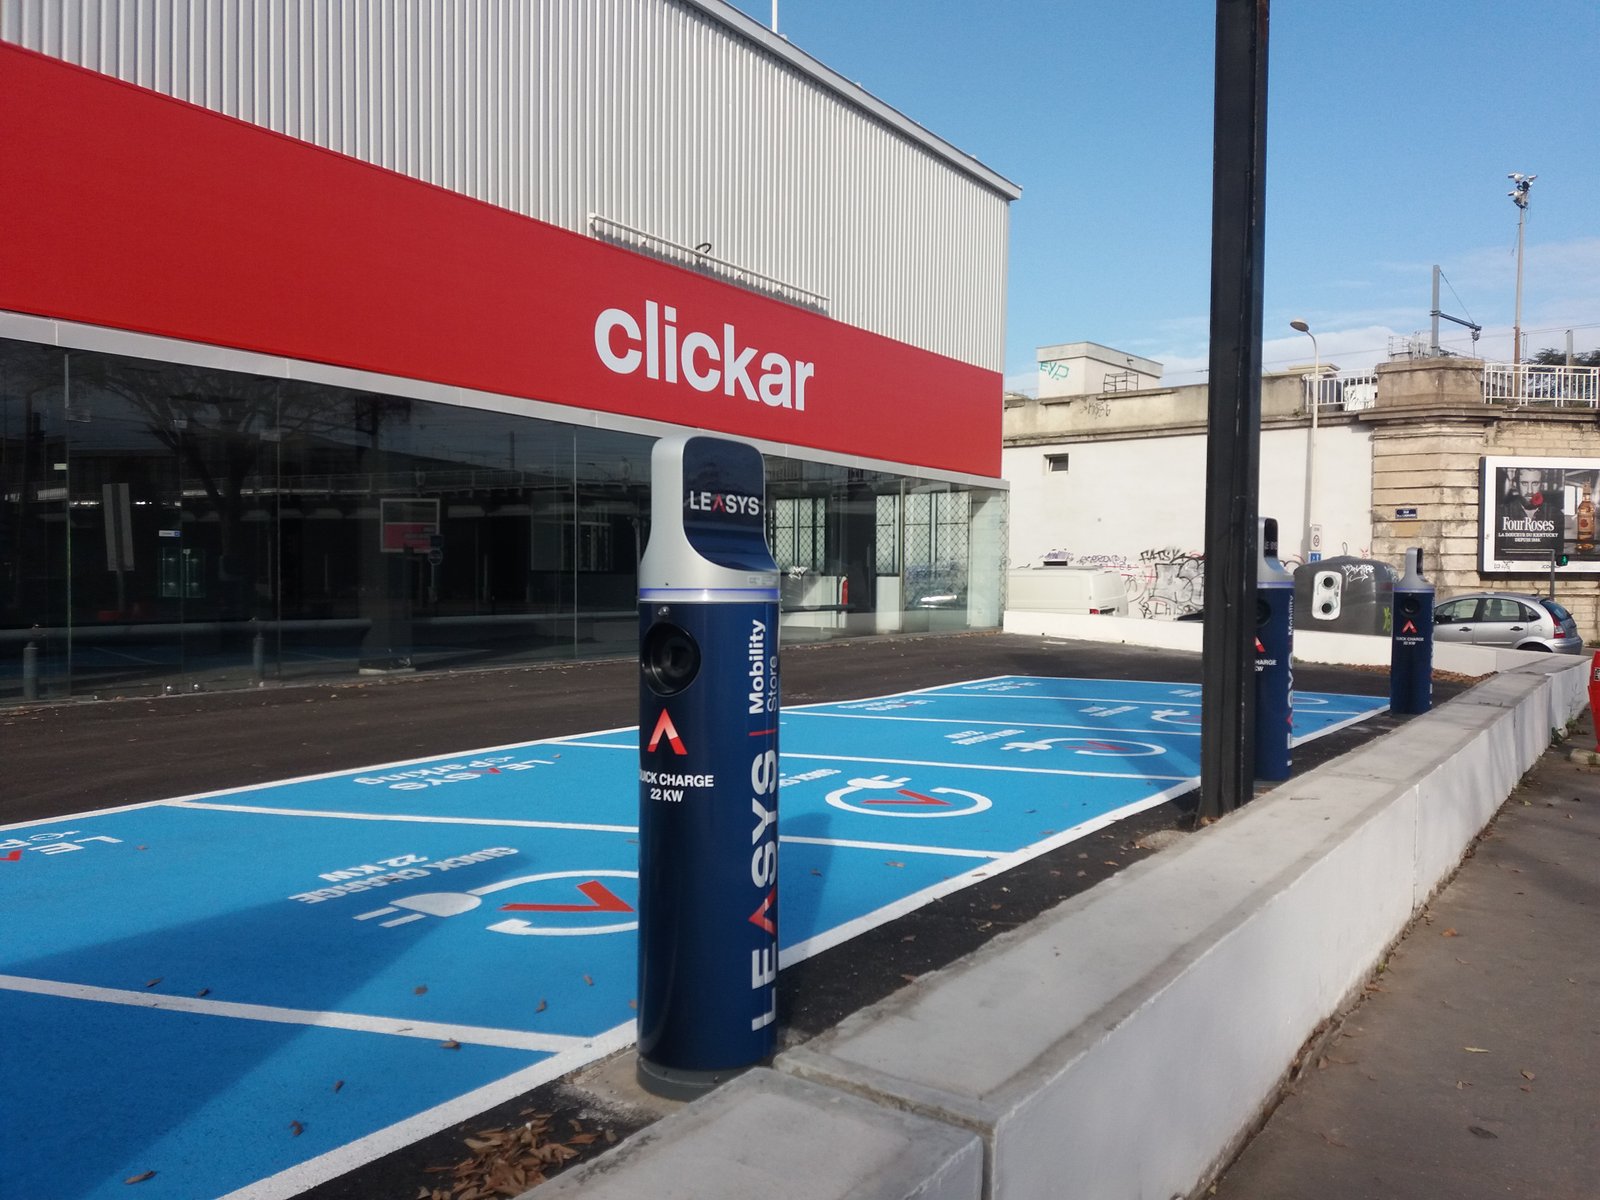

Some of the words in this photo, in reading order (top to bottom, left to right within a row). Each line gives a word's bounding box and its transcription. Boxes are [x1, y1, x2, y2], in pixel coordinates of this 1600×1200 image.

[594, 299, 815, 412] clickar
[690, 490, 760, 515] LEASYS
[1524, 516, 1555, 532] Roses
[749, 619, 766, 715] Mobility
[766, 656, 778, 713] Store
[659, 773, 714, 788] CHARGE
[650, 788, 662, 800] 22
[663, 789, 684, 802] KW
[377, 854, 428, 867] 22
[421, 847, 519, 871] QUICK
[318, 864, 386, 882] KW
[288, 868, 431, 904] CHARGE
[748, 749, 777, 1031] LEASYS
